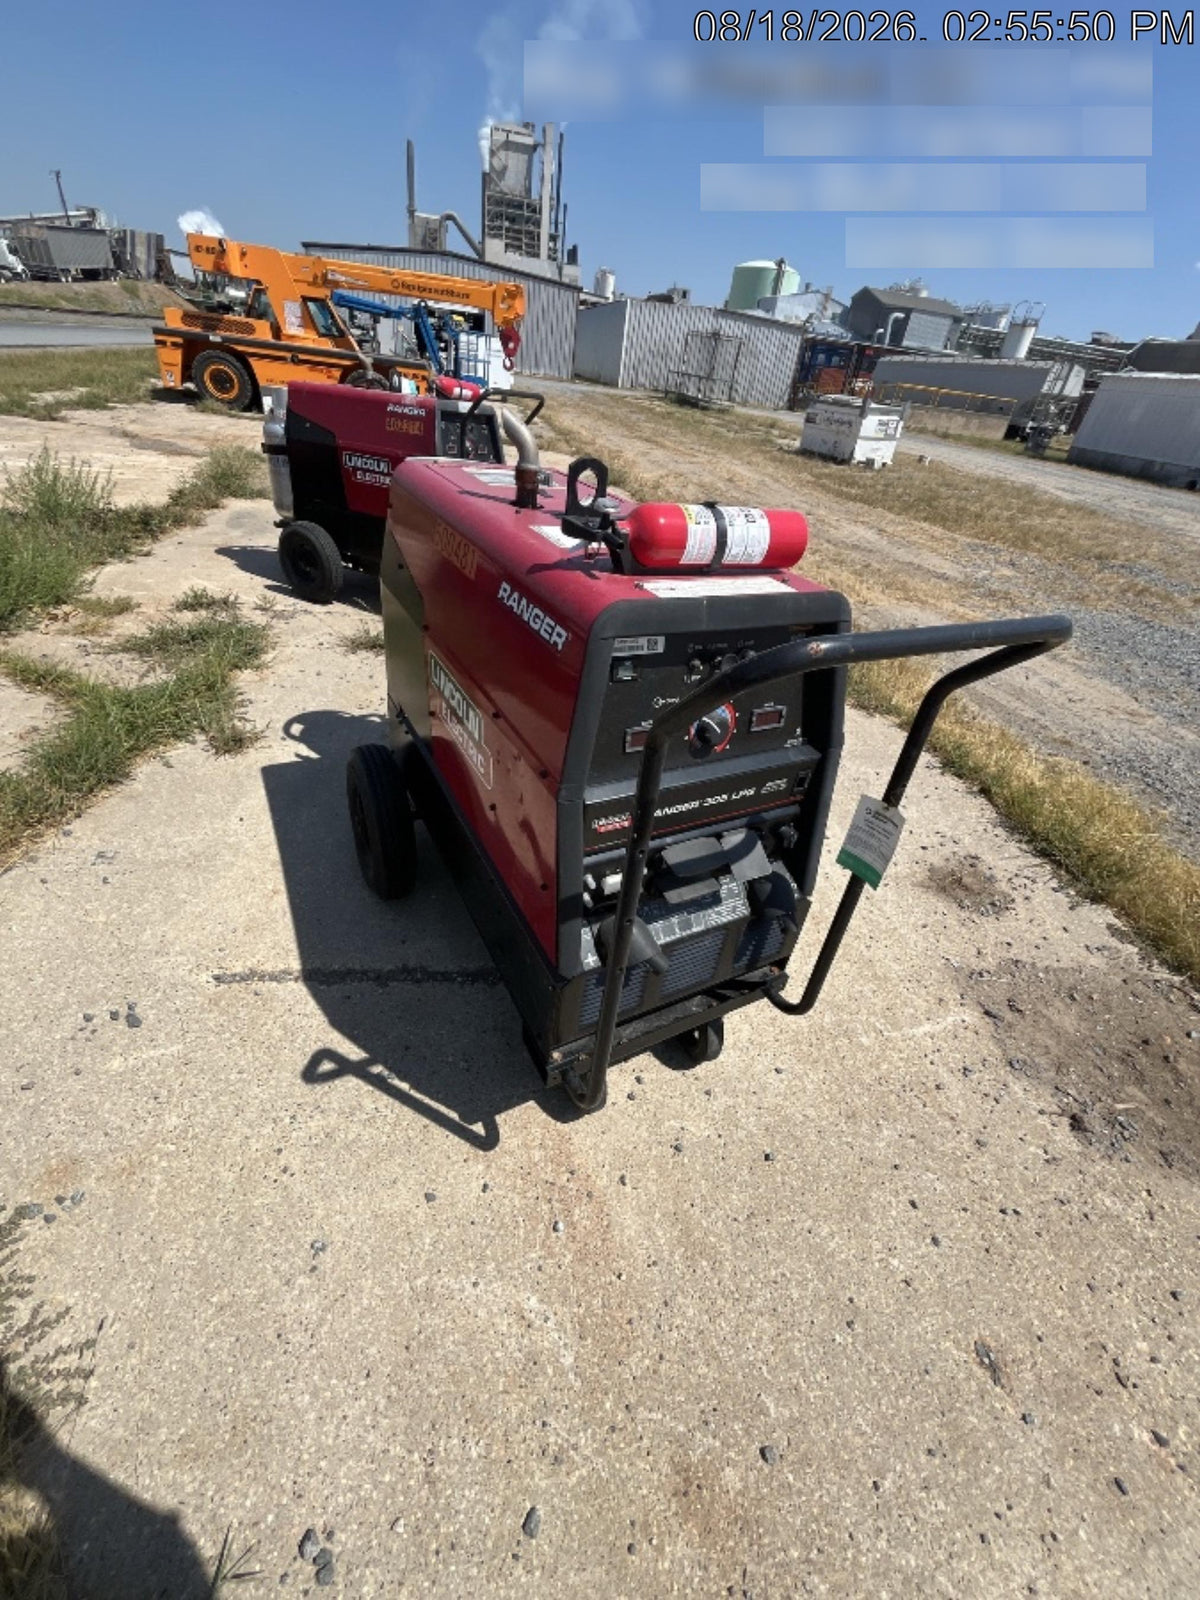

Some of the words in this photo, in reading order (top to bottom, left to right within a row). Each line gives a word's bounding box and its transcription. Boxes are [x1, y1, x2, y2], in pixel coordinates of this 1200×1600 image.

[387, 403, 426, 416] RANGER
[346, 454, 388, 474] LINCOLN
[356, 470, 391, 486] ELECTRI
[497, 581, 568, 650] RANGER
[431, 658, 479, 742] LINCOLN
[441, 700, 485, 774] ELECTRIC
[653, 800, 700, 817] ANGER
